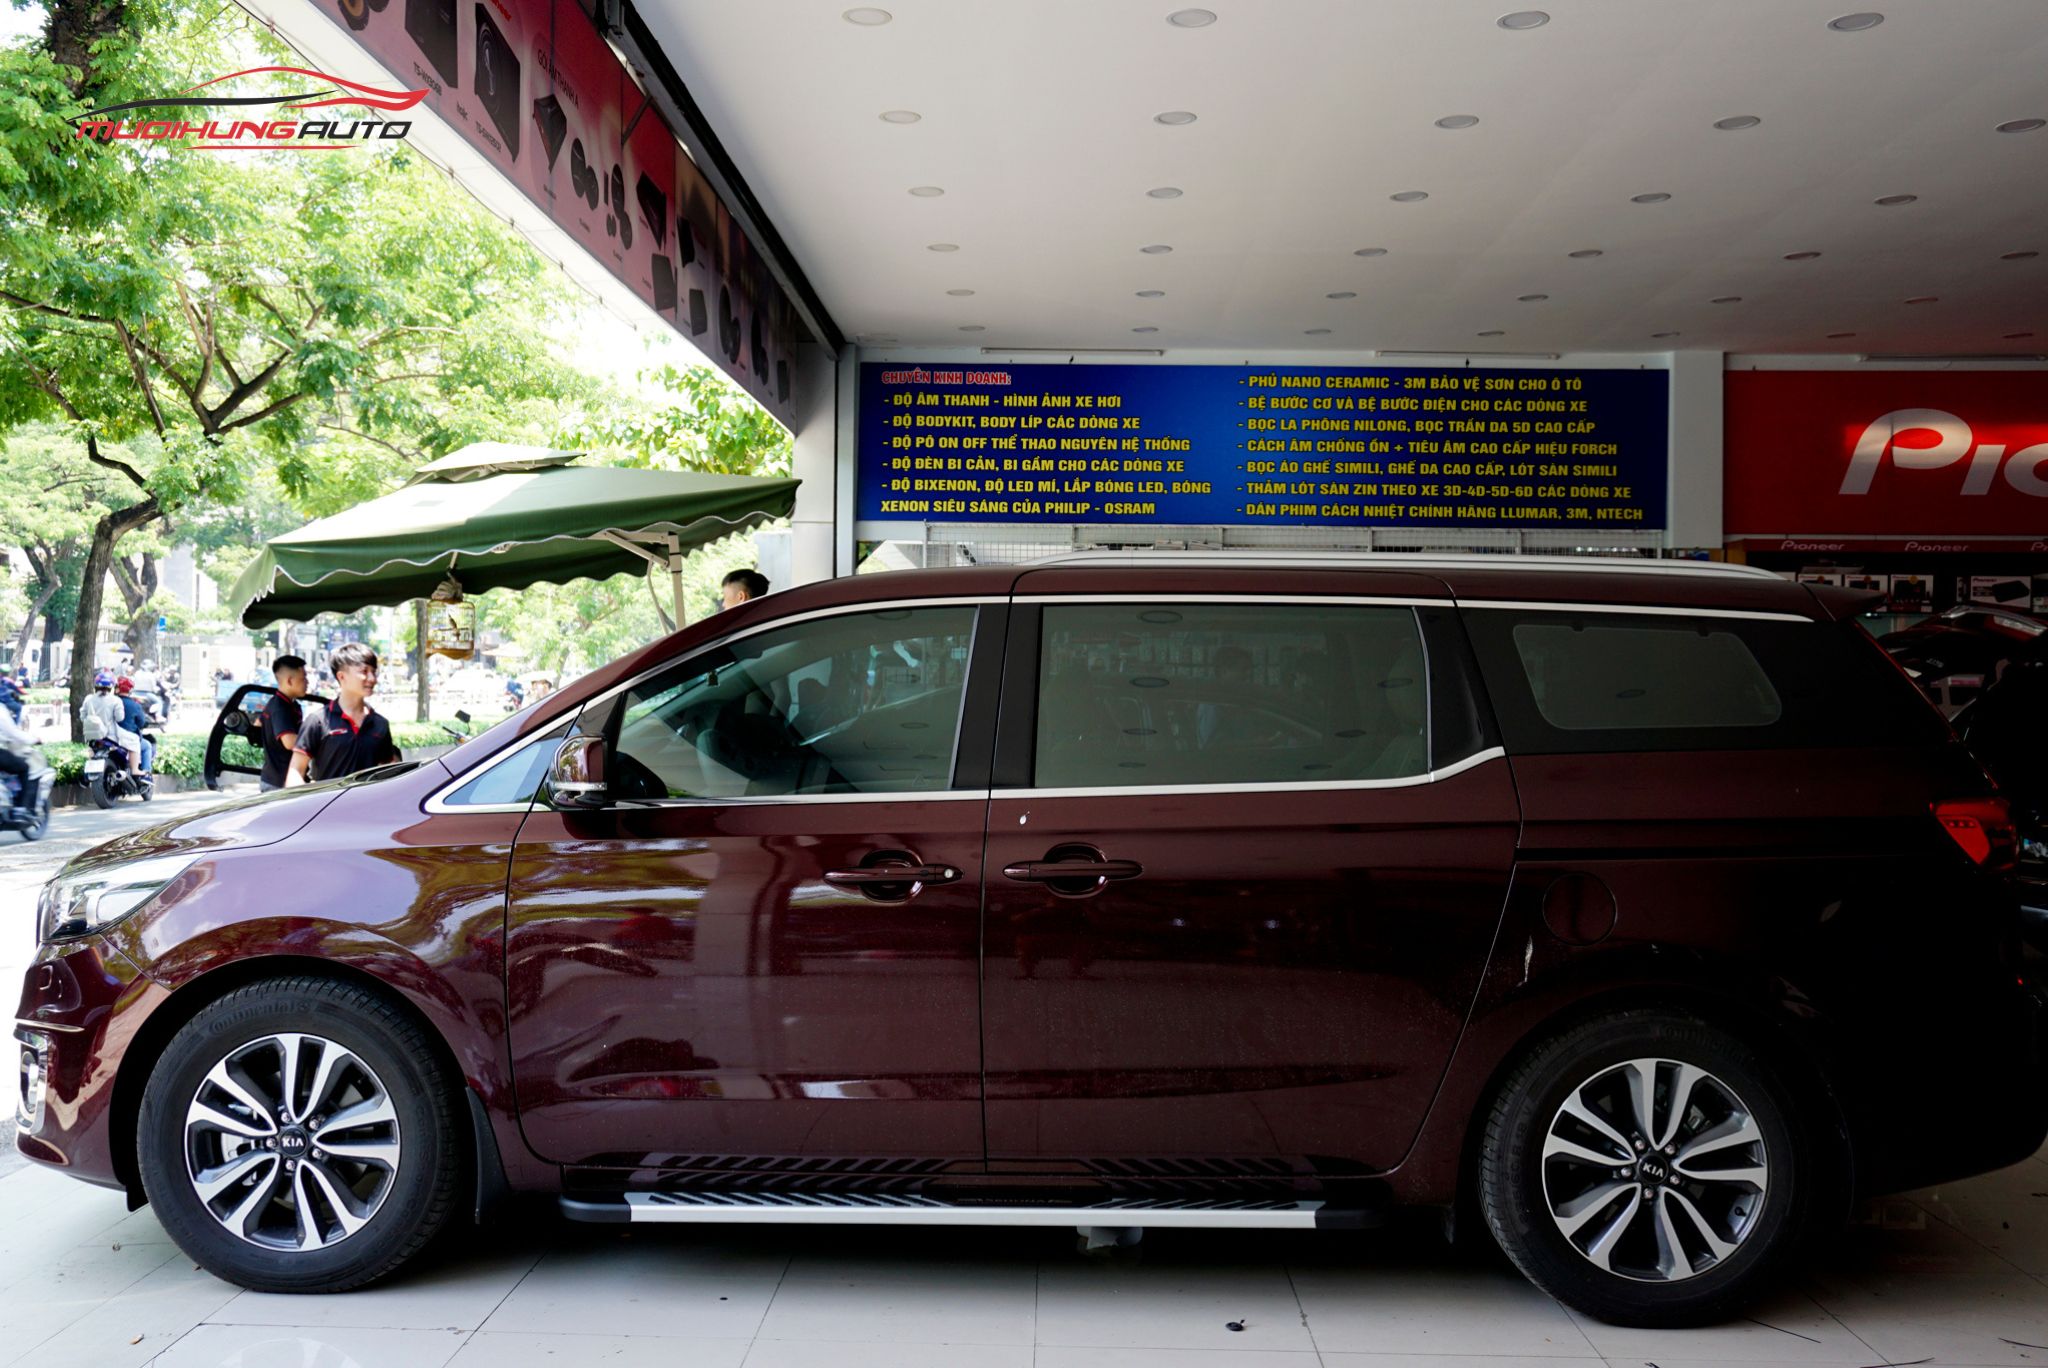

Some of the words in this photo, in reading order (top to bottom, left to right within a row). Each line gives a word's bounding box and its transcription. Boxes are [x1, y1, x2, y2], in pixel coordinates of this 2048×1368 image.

[882, 367, 930, 385] CHUYÊN
[934, 370, 962, 385] KINH
[966, 370, 1011, 385] DOANH:
[1281, 376, 1321, 388] NANO
[1326, 377, 1389, 389] CERAMIC
[1404, 377, 1426, 389] 3M
[1430, 375, 1459, 390] BẢO
[1463, 375, 1480, 392] VỆ
[1485, 378, 1514, 390] SƠN
[1518, 379, 1547, 390] CHO
[1551, 376, 1561, 391] Ô
[1565, 376, 1582, 391] TÔ
[893, 392, 912, 409] ĐỘ
[916, 392, 939, 406] ÂM
[943, 395, 989, 407] THANH
[1003, 392, 1037, 407] HÌNH
[1042, 393, 1071, 407] ẢNH
[1075, 395, 1093, 407] XE
[1097, 396, 1121, 408] HƠI
[1248, 395, 1266, 411] BỆ
[1271, 395, 1308, 409] BƯỚC
[1313, 398, 1332, 409] CƠ
[1336, 396, 1354, 409] VÀ
[1358, 396, 1376, 412] BỆ
[1381, 396, 1419, 410] BƯỚC
[1423, 396, 1456, 413] ĐIỆN
[1461, 399, 1489, 411] CHO
[1494, 397, 1522, 411] CÁC
[1570, 400, 1587, 412] XE
[893, 414, 912, 430] ĐỘ
[916, 416, 976, 428] BODYKIT,
[980, 417, 1016, 428] BODY
[1021, 414, 1042, 428] LÍP
[1047, 414, 1075, 428] CÁC
[1122, 417, 1140, 428] XE
[1248, 419, 1276, 433] BỌC
[1280, 419, 1297, 430] LA
[1301, 417, 1350, 431] PHÔNG
[1354, 420, 1410, 432] NILONG,
[1415, 421, 1443, 434] BỌC
[1490, 421, 1508, 432] DA
[1513, 422, 1531, 433] 5D
[1535, 422, 1563, 433] CAO
[1567, 419, 1595, 433] CẤP
[892, 434, 911, 451] ĐỘ
[915, 434, 934, 449] PÔ
[939, 437, 958, 449] ON
[963, 437, 987, 449] OFF
[991, 434, 1016, 449] THỂ
[1021, 437, 1056, 449] THAO
[1061, 435, 1117, 450] NGUYÊN
[1122, 436, 1139, 453] HỆ
[1144, 435, 1190, 450] THỐNG
[1248, 438, 1285, 452] CÁCH
[1290, 438, 1312, 452] ÂM
[1317, 438, 1365, 452] CHỐNG
[1408, 439, 1438, 453] TIÊU
[1443, 440, 1465, 453] ÂM
[1470, 443, 1498, 454] CAO
[1502, 439, 1531, 454] CẤP
[1535, 441, 1567, 457] HIỆU
[1571, 443, 1617, 454] FORCH
[892, 456, 911, 472] ĐỘ
[915, 456, 943, 470] ĐÈN
[948, 459, 962, 470] BI
[1003, 459, 1017, 470] BI
[1058, 459, 1086, 471] CHO
[1091, 457, 1119, 471] CÁC
[1167, 460, 1184, 471] XE
[1247, 462, 1275, 476] BỌC
[1280, 459, 1298, 474] ÁO
[1303, 459, 1330, 474] GHẾ
[1335, 463, 1383, 476] SIMILI,
[1388, 460, 1415, 475] GHẾ
[1420, 463, 1439, 475] DA
[1443, 464, 1471, 476] CAO
[1475, 460, 1505, 477] CẤP,
[1510, 462, 1535, 476] LÓT
[1573, 465, 1617, 477] SIMILI
[891, 477, 910, 493] ĐỘ
[914, 480, 980, 492] BIXENON,
[985, 478, 1004, 494] ĐỘ
[1008, 480, 1034, 492] LED
[1038, 478, 1060, 493] MÍ,
[1095, 479, 1134, 492] BÓNG
[1138, 481, 1167, 493] LED,
[1172, 479, 1211, 493] BÓNG
[1247, 480, 1286, 495] THẢM
[1291, 481, 1315, 495] LÓT
[1353, 484, 1377, 495] ZIN
[1382, 484, 1417, 496] THEO
[1421, 484, 1439, 496] XE
[1444, 485, 1533, 497] 3D-4D-5D-6D
[1537, 483, 1566, 497] CÁC
[1613, 486, 1631, 498] XE
[881, 501, 929, 512] XENON
[933, 498, 965, 513] SIÊU
[969, 499, 1008, 513] SÁNG
[1012, 499, 1041, 513] CỦA
[1045, 502, 1090, 513] PHILIP
[1104, 502, 1155, 514] OSRAM
[1246, 502, 1276, 516] DÁN
[1280, 505, 1317, 517] PHIM
[1321, 502, 1359, 517] CÁCH
[1364, 503, 1405, 520] NHIỆT
[1409, 503, 1452, 518] CHÍNH
[1501, 507, 1562, 520] LLUMAR,
[1566, 507, 1592, 520] 3M,
[1597, 507, 1643, 519] NTECH
[1781, 540, 1846, 551] Pioneer
[1904, 541, 1969, 552] Pioneer
[281, 1137, 304, 1148] KIA
[1641, 1162, 1664, 1178] KIA
